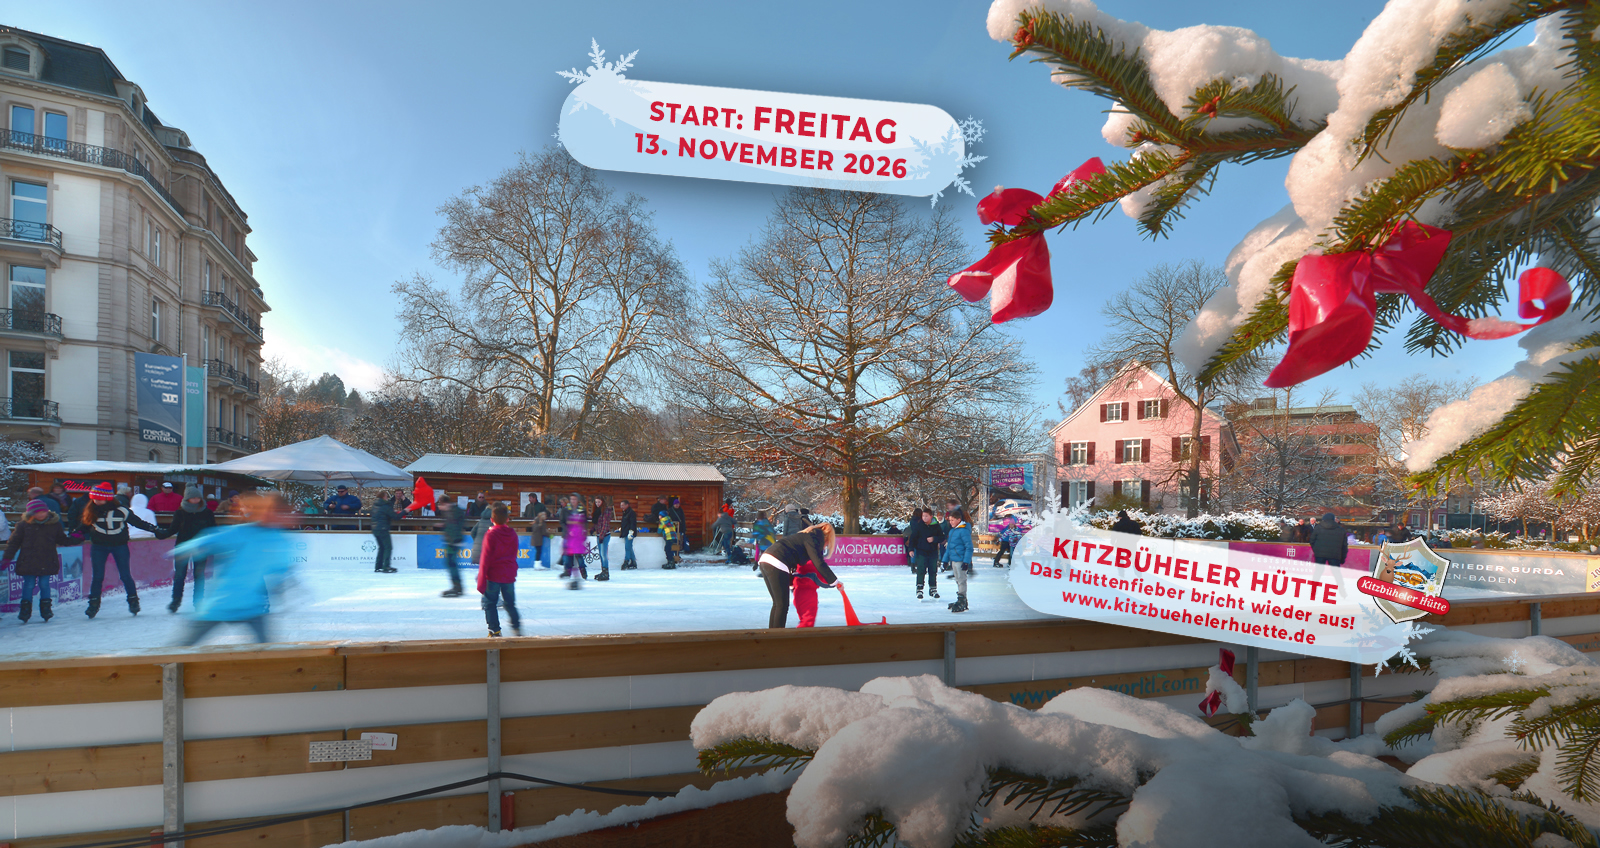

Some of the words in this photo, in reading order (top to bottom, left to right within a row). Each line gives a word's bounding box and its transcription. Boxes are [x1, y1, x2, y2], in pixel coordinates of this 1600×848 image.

[143, 428, 171, 437] media
[1251, 557, 1316, 567] FESTSPIELH
[1451, 562, 1504, 573] RIEDER
[1511, 566, 1565, 576] BURDA
[1446, 573, 1518, 585] EN-BADEN
